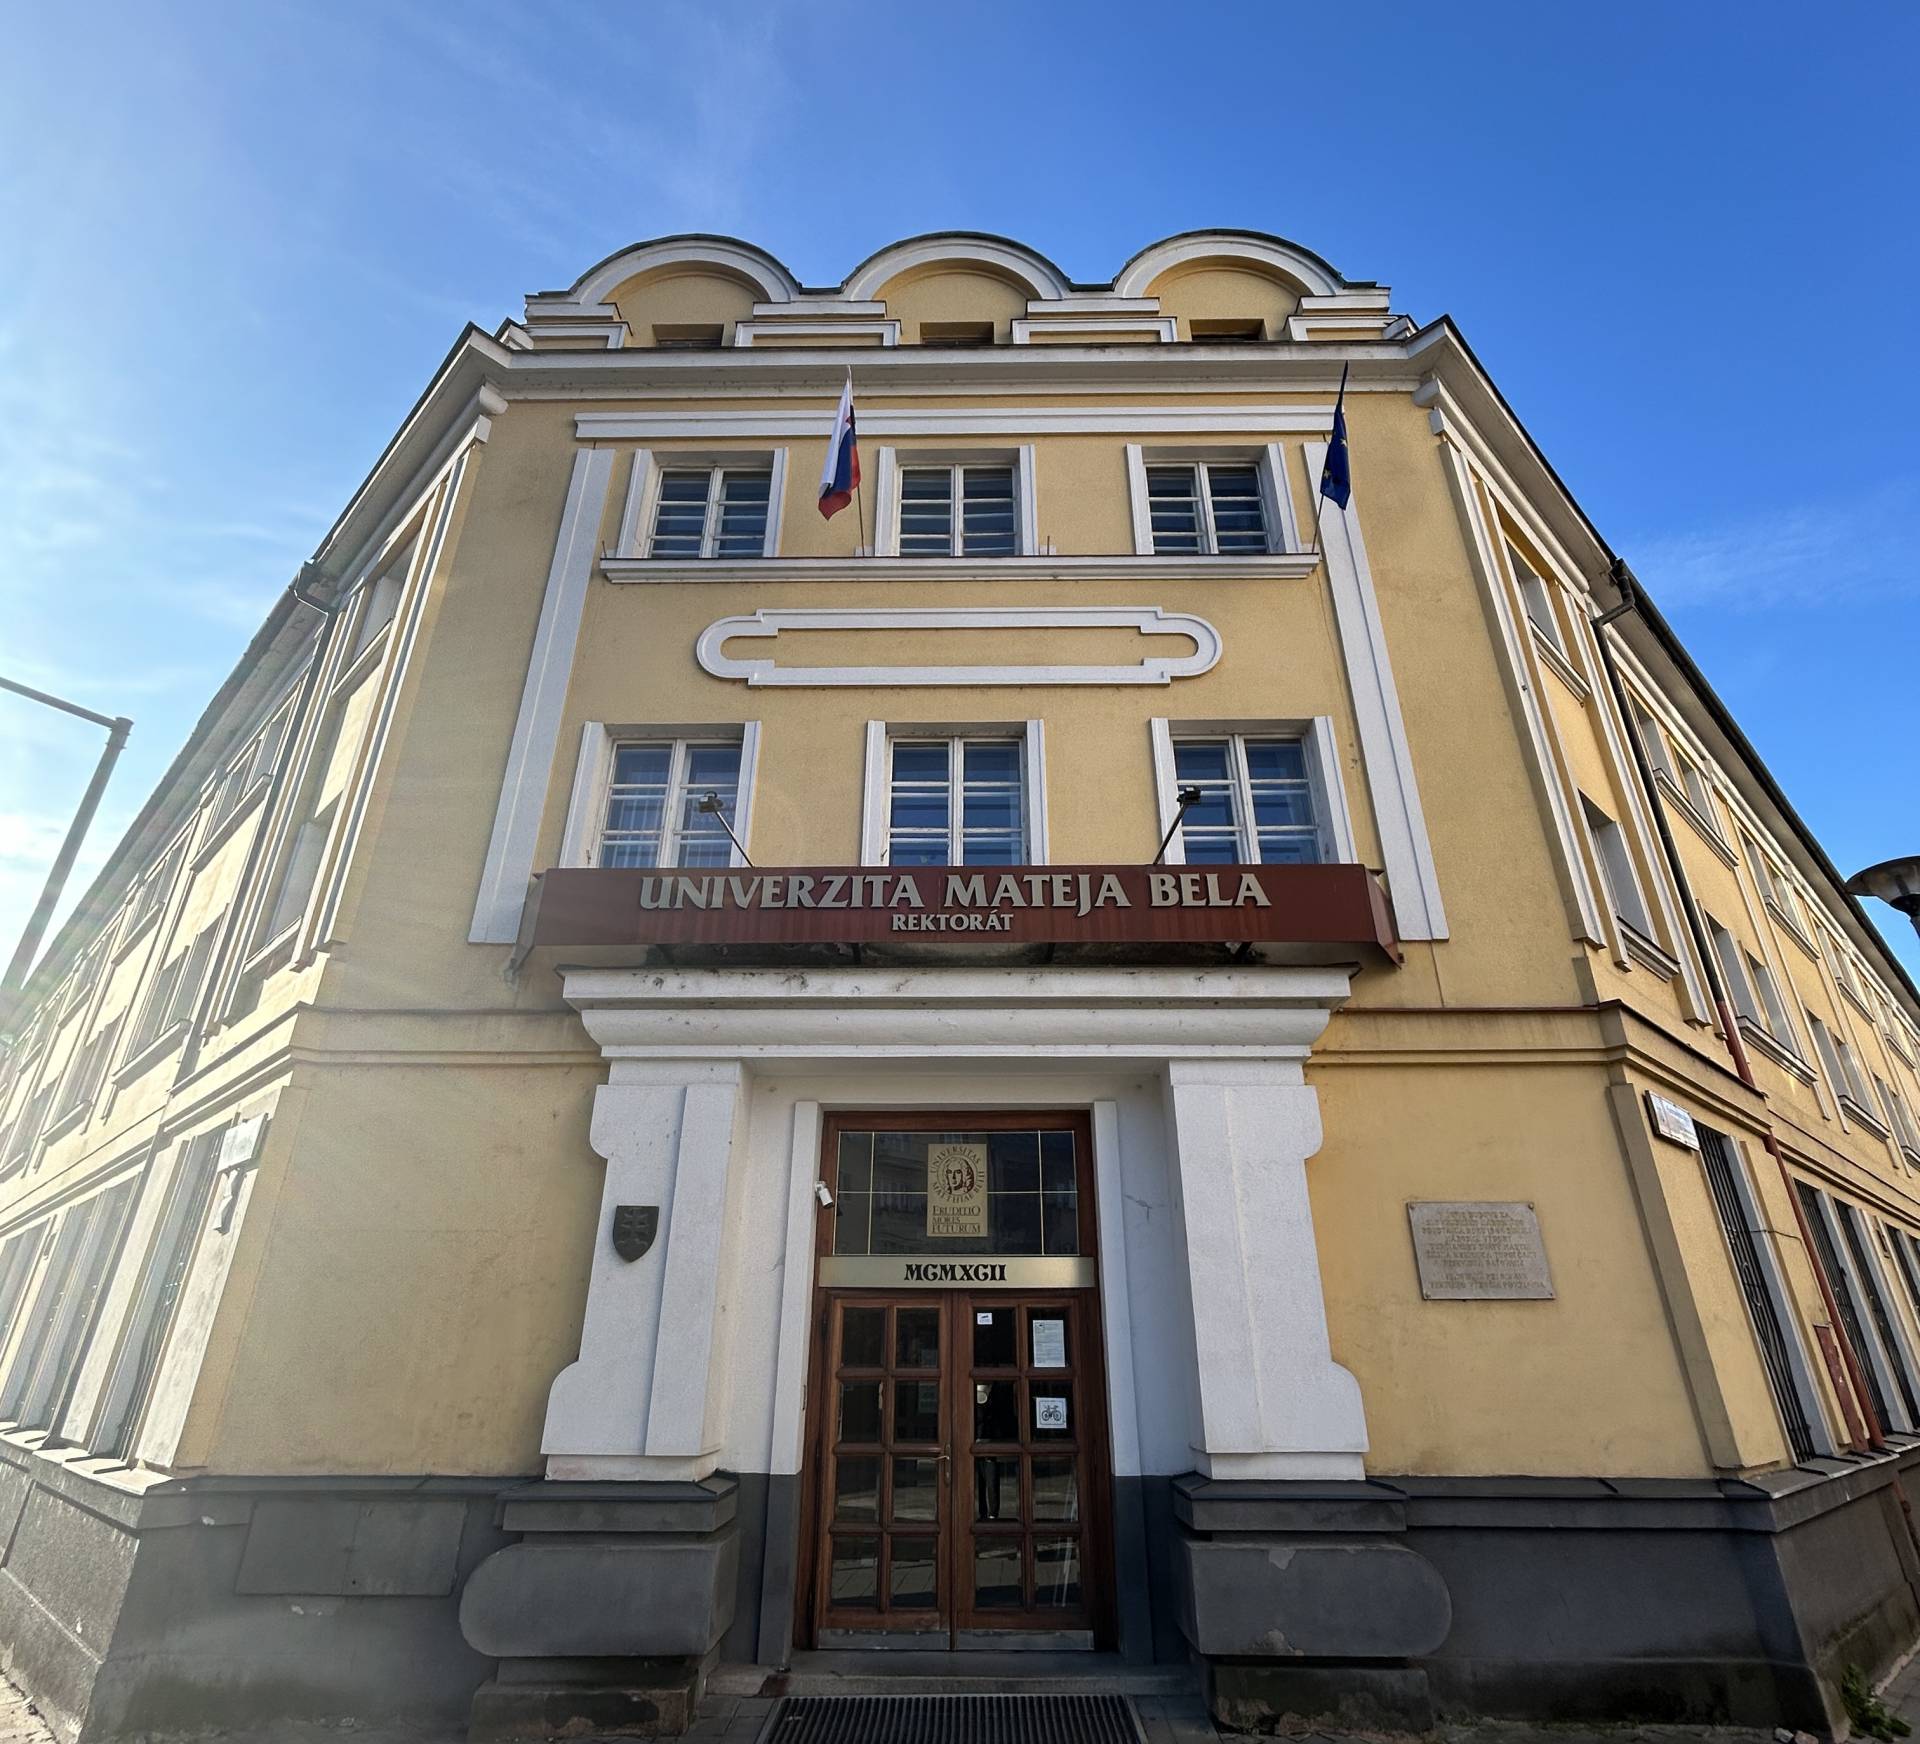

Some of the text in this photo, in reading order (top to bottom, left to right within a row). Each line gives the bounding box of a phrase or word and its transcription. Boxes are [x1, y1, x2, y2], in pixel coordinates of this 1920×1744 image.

[639, 873, 1272, 917] UNIVERZITA MATEJA BELA
[892, 910, 1014, 932] REKTORÁT
